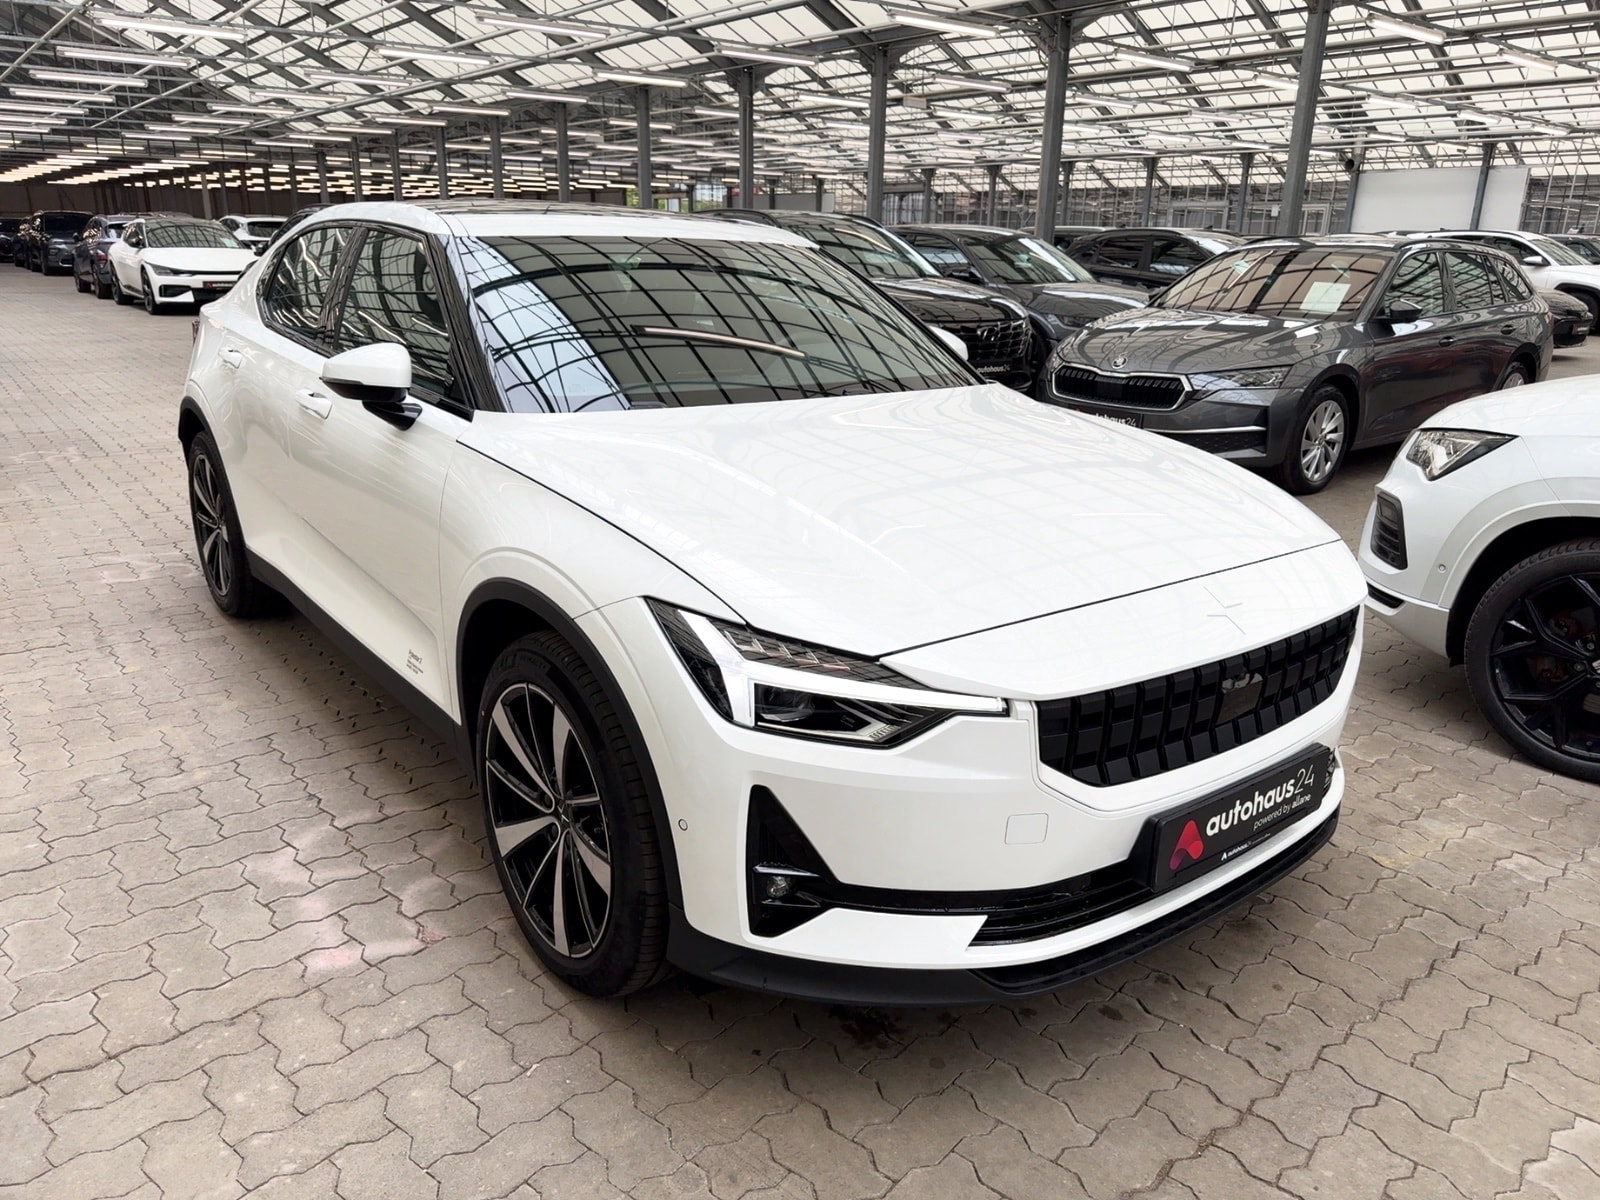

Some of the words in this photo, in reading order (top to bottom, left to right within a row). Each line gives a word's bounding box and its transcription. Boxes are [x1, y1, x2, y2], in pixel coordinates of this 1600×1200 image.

[1206, 764, 1315, 836] autohaus24
[1253, 805, 1282, 831] powered
[1282, 804, 1291, 814] by
[1291, 793, 1311, 809] allane
